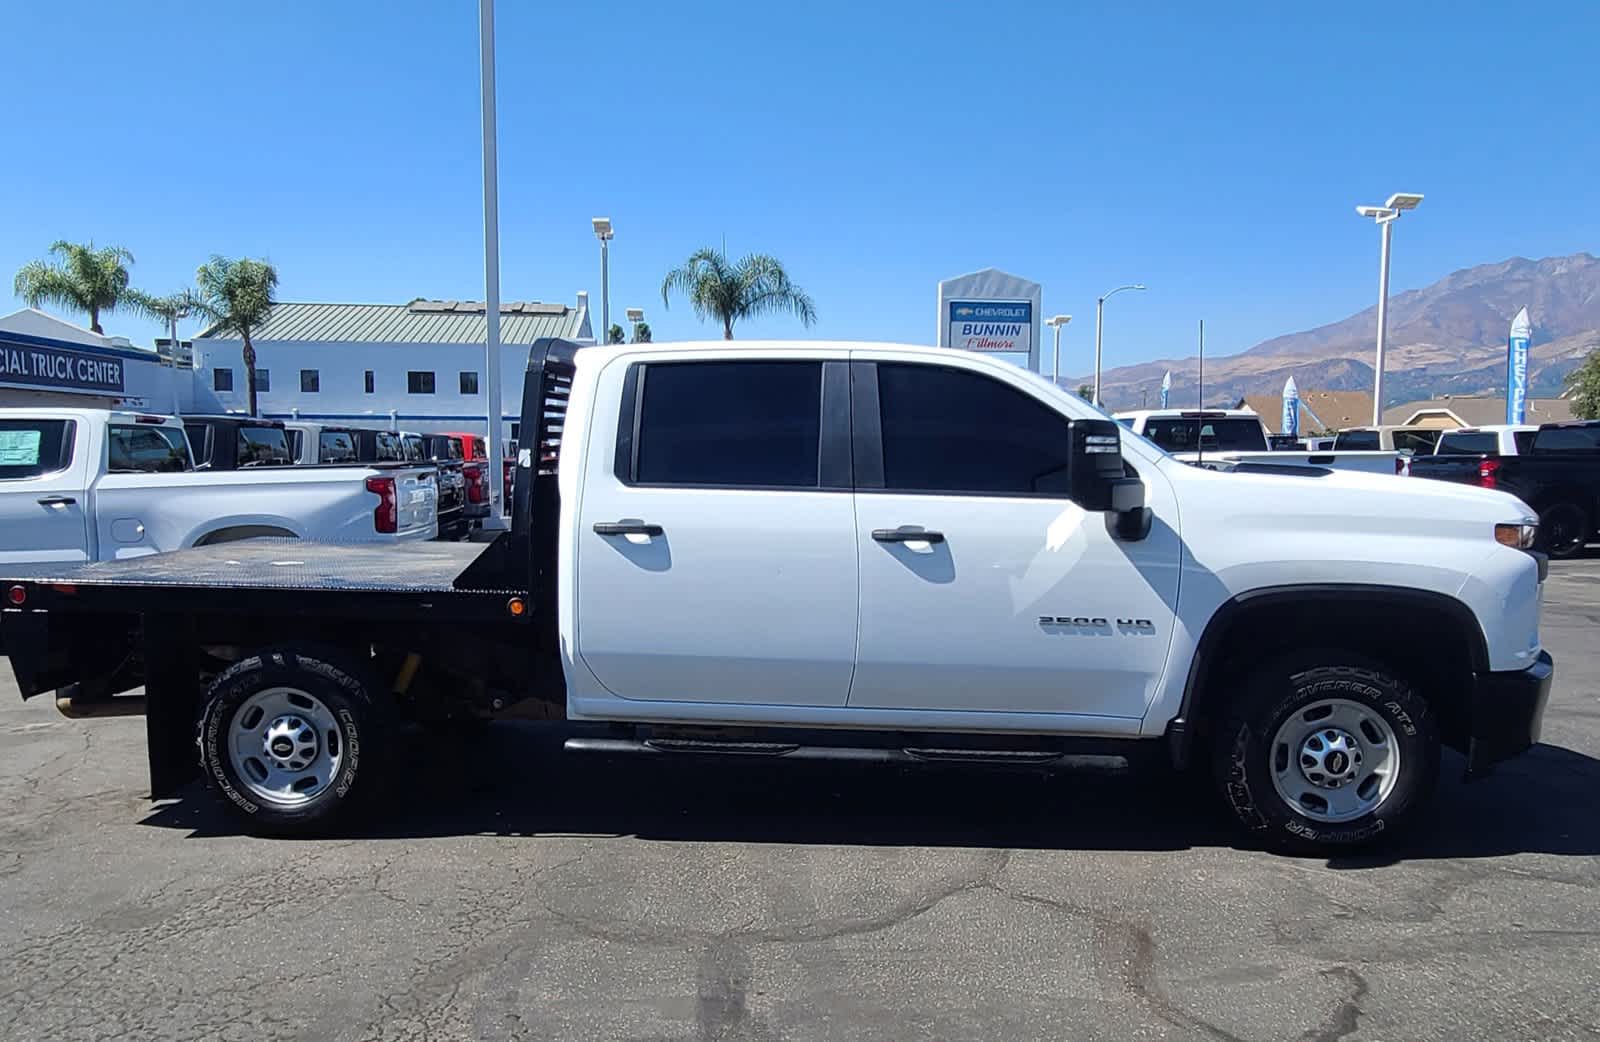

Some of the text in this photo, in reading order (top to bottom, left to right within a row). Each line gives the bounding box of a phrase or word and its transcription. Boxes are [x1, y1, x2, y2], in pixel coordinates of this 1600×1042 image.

[974, 307, 1025, 317] CHEVROLET
[962, 323, 1021, 337] BUNNIN
[31, 352, 75, 380] TRUCK
[77, 358, 121, 385] CENTER
[1116, 618, 1154, 629] HD
[1384, 700, 1417, 736] AT3
[336, 708, 360, 798] COOPER
